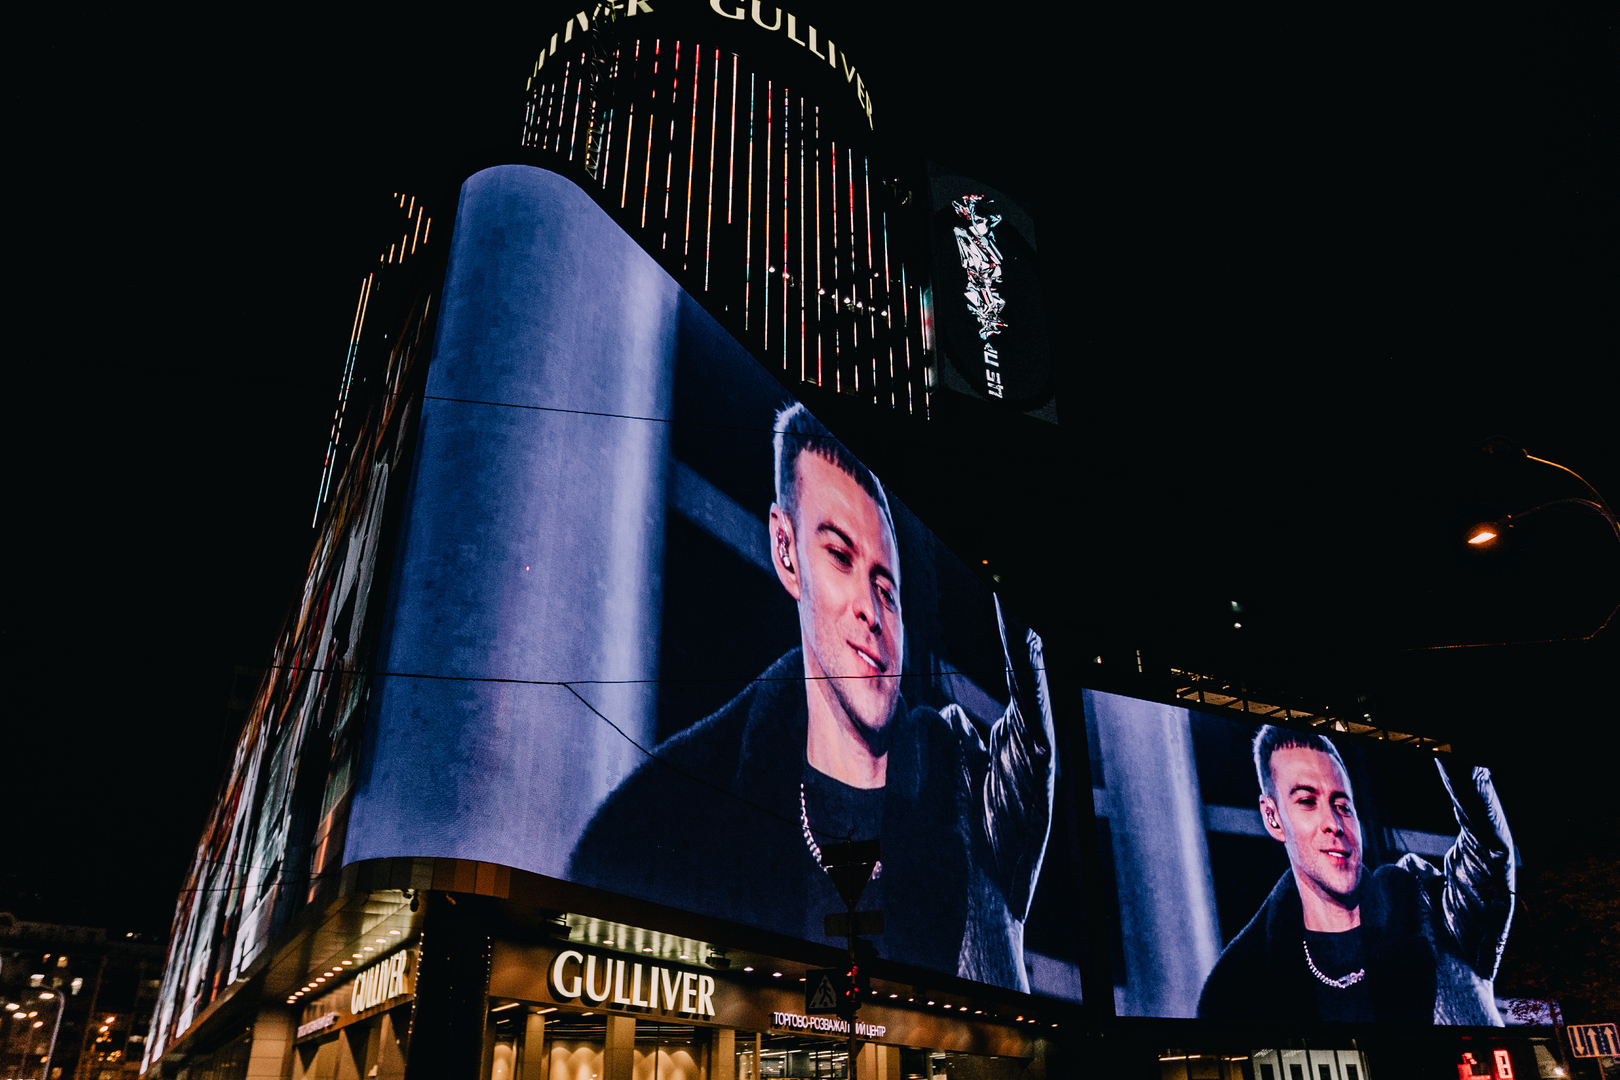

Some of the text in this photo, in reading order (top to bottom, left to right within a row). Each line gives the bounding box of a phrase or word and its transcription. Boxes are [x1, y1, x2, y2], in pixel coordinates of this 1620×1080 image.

[351, 949, 407, 1014] GULLIVER
[553, 950, 715, 1016] GULLIVER
[774, 1012, 887, 1039] ТОРГОВО-РОЗВАЖАЛИЙ ЦЕНТР
